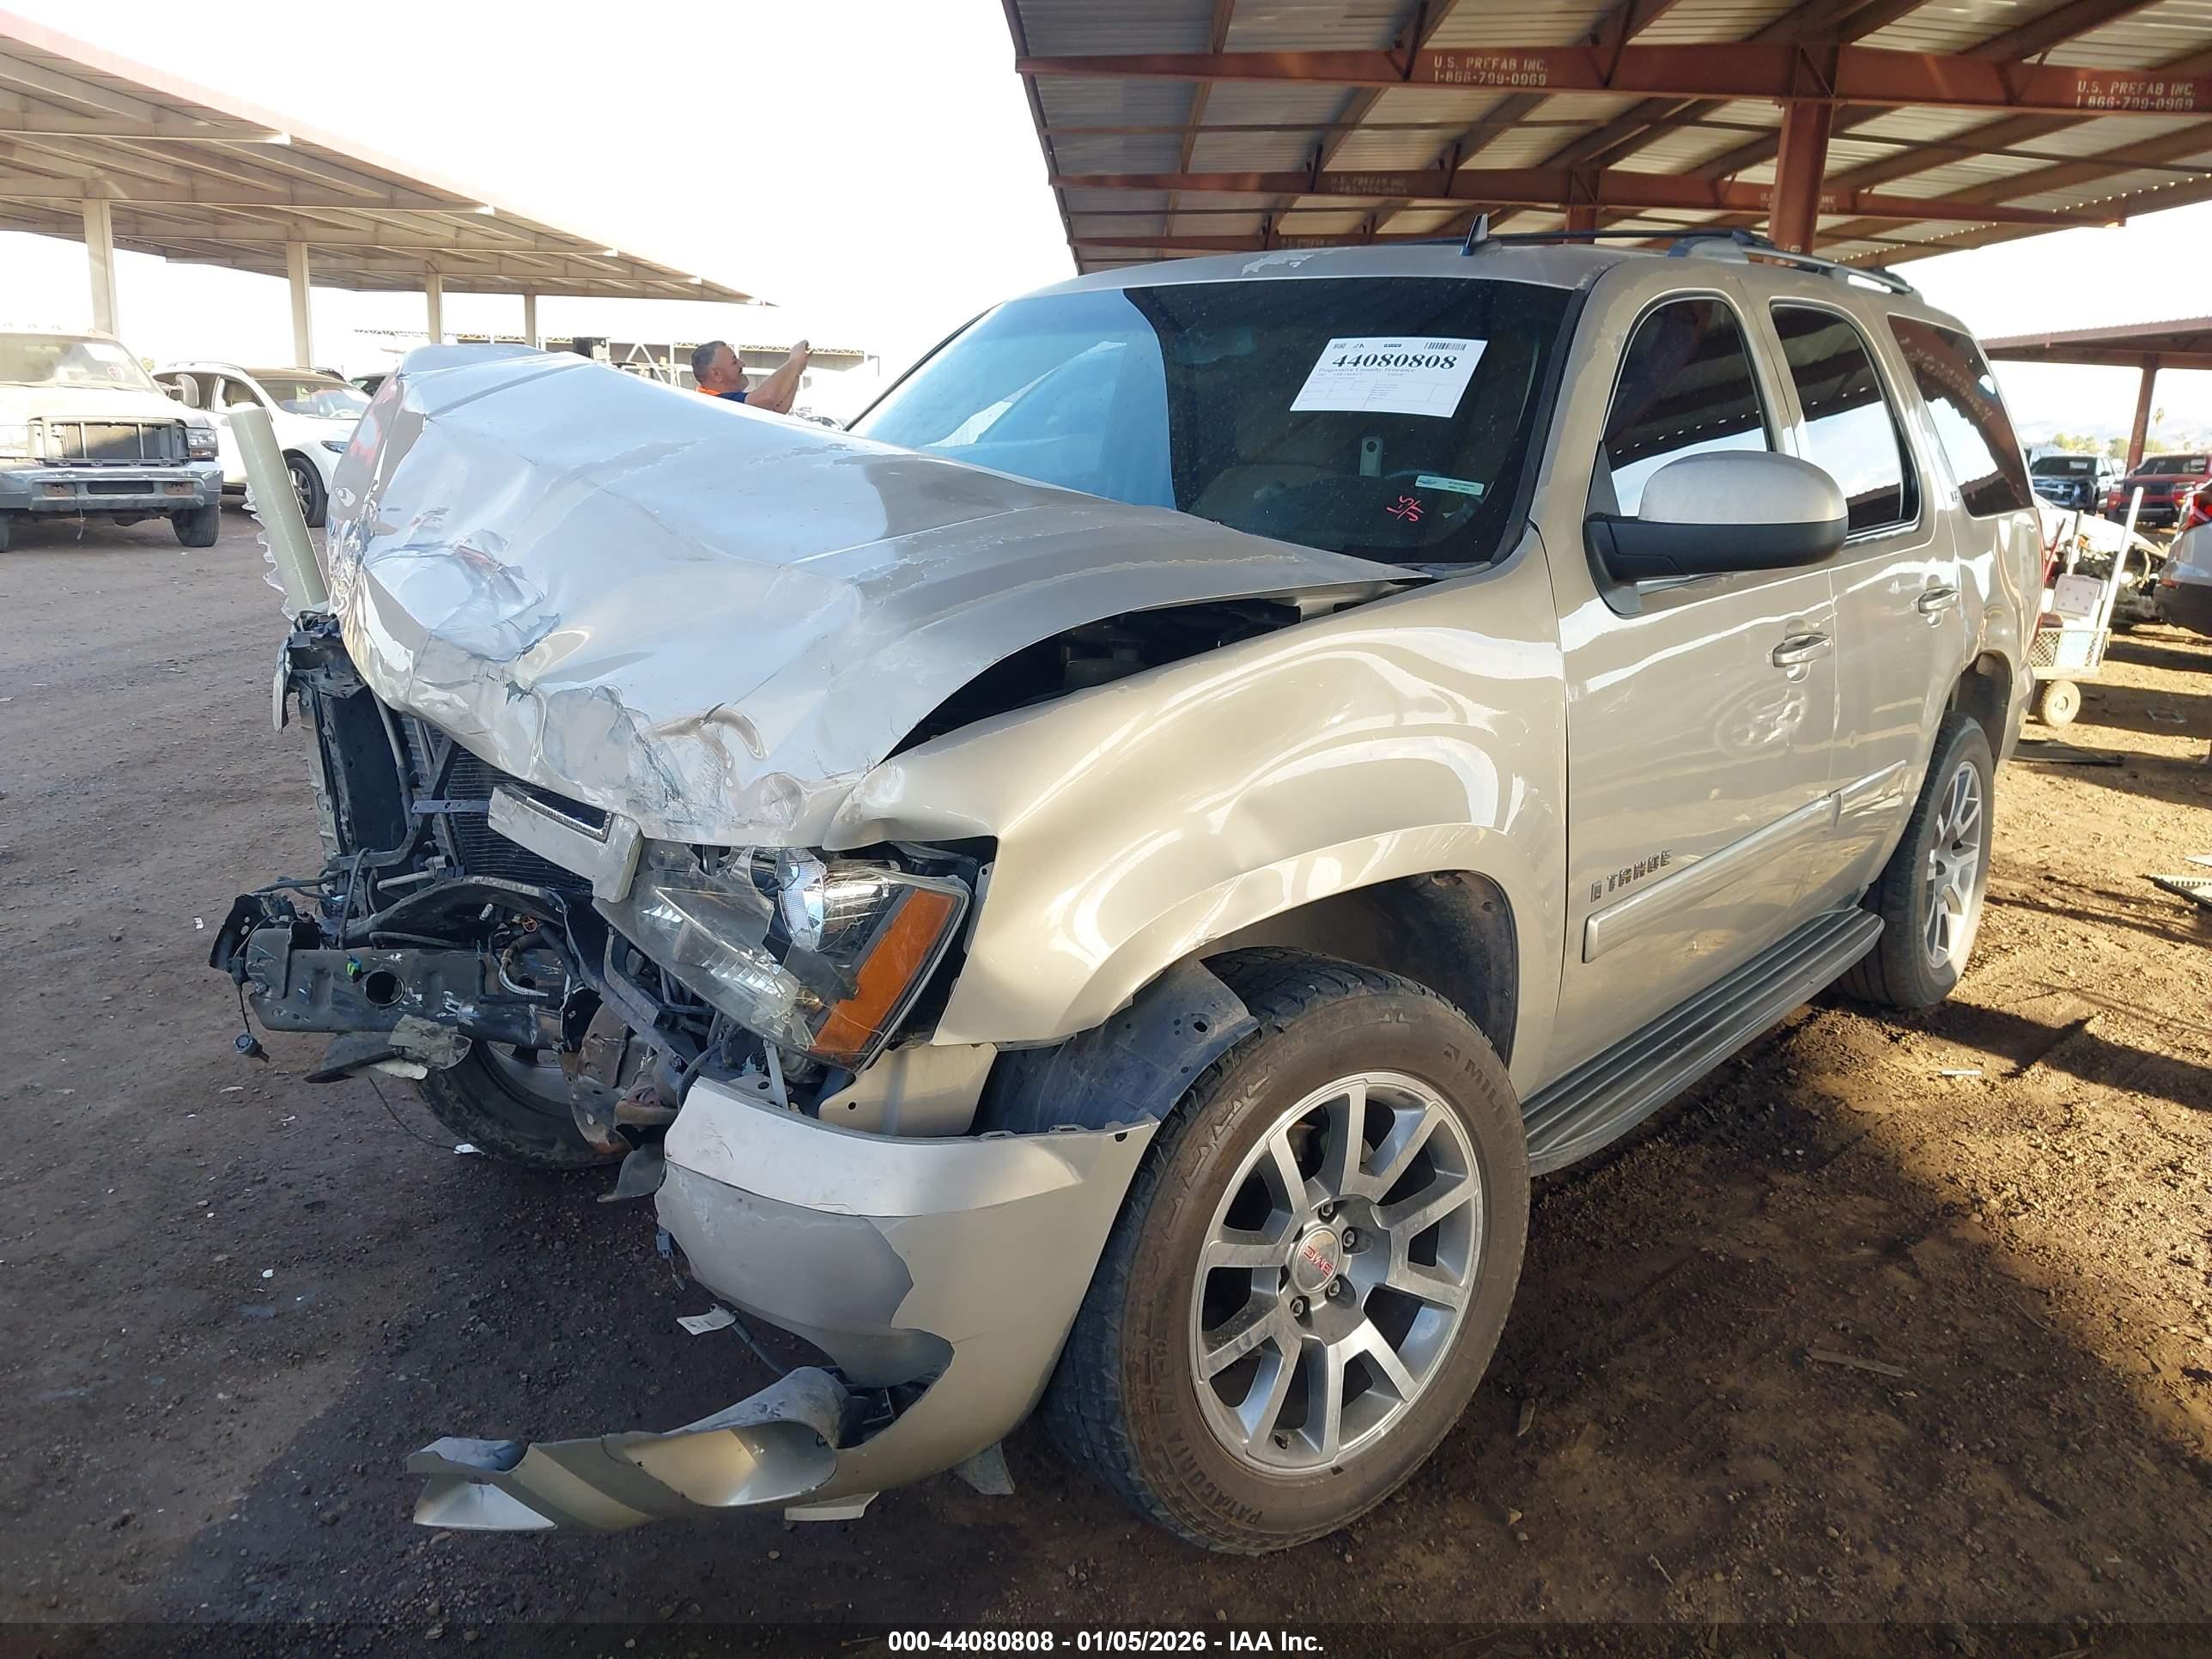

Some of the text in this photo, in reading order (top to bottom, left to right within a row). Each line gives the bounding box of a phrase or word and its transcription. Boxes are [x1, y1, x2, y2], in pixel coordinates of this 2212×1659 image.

[1434, 55, 1547, 72] U.S. PREFAB INC.
[2078, 81, 2102, 94] U.S.
[2111, 82, 2164, 95] PREFAB
[1332, 353, 1457, 369] 44080808
[1304, 1244, 1334, 1278] GMC
